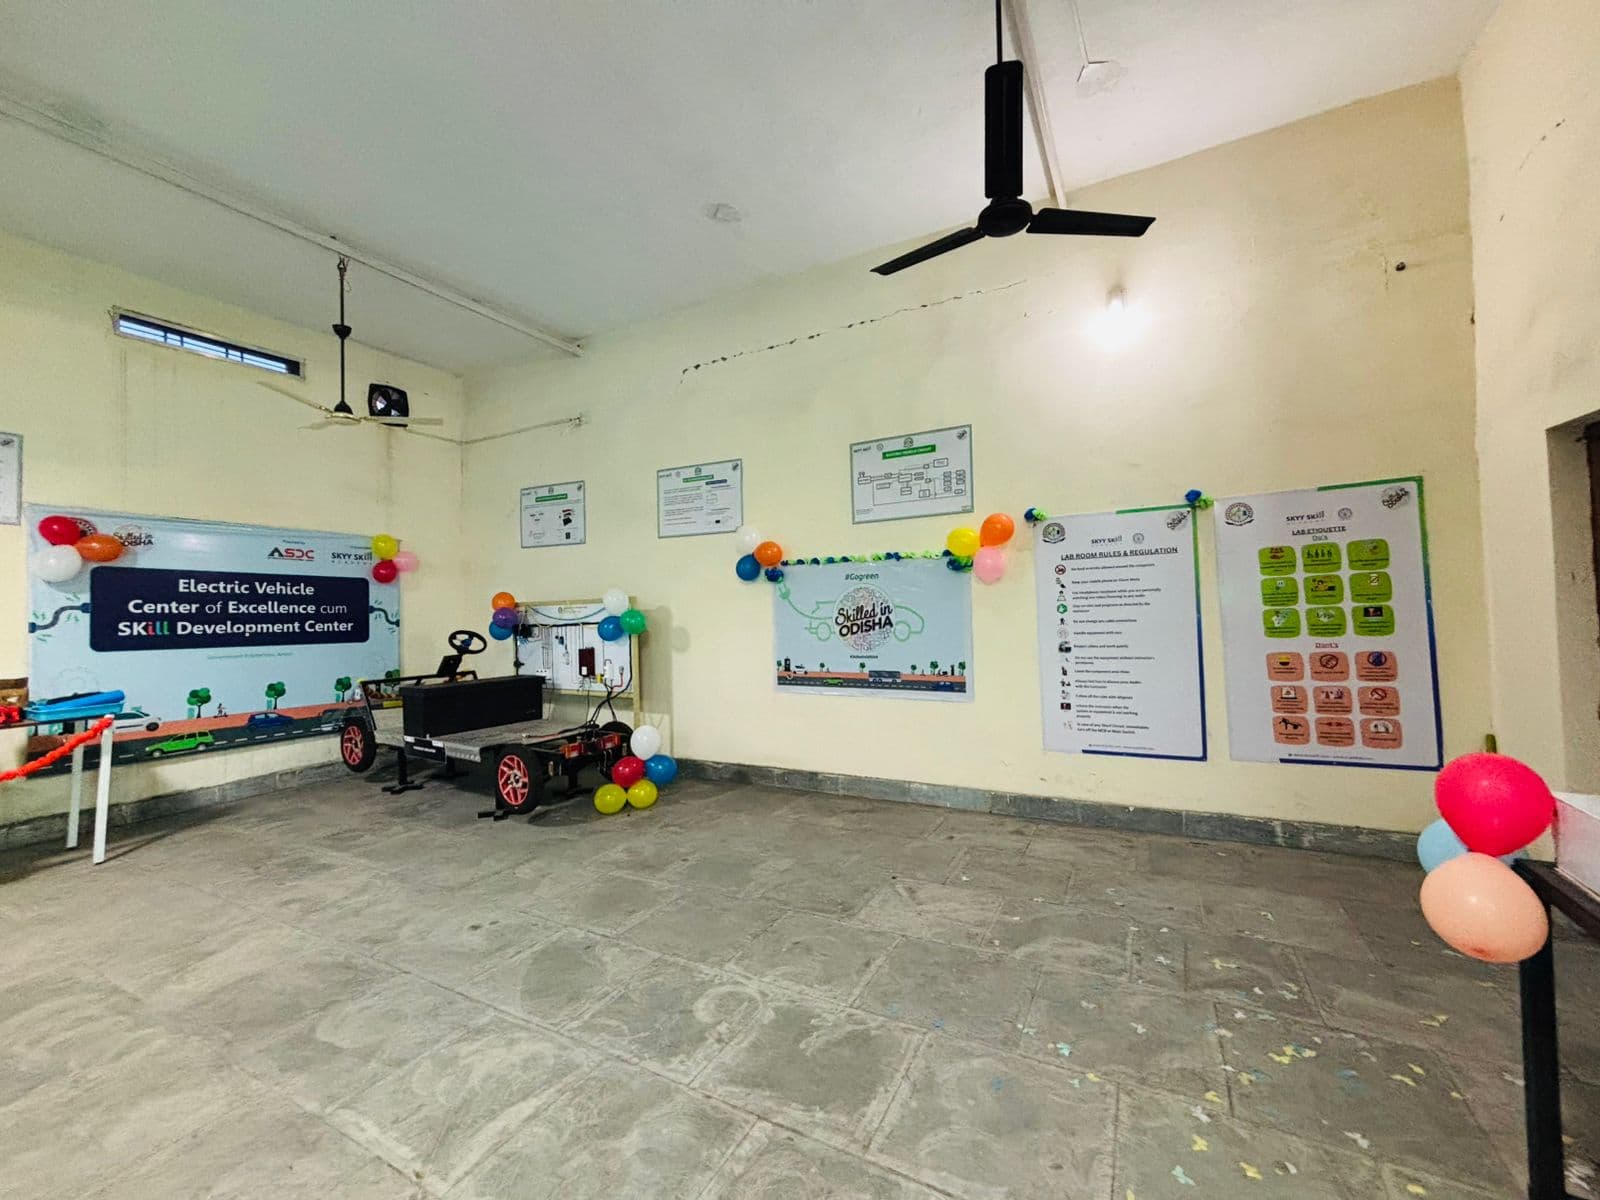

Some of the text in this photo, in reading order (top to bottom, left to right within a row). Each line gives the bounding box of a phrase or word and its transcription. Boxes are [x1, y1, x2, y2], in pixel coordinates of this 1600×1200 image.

[1307, 526, 1346, 534] ETIQUETTE
[267, 547, 315, 560] ASDC
[331, 551, 352, 560] SKYY
[1075, 552, 1097, 560] ROOM
[1098, 550, 1121, 559] RULES
[1129, 546, 1178, 556] REGULATION
[845, 573, 880, 581] #Gogreen
[179, 579, 315, 595] Electric Vehicle
[128, 600, 347, 613] Center of Excellence cum
[835, 602, 893, 626] Skilled in
[118, 620, 354, 637] SKill Development Center
[839, 616, 894, 637] ODISHA
